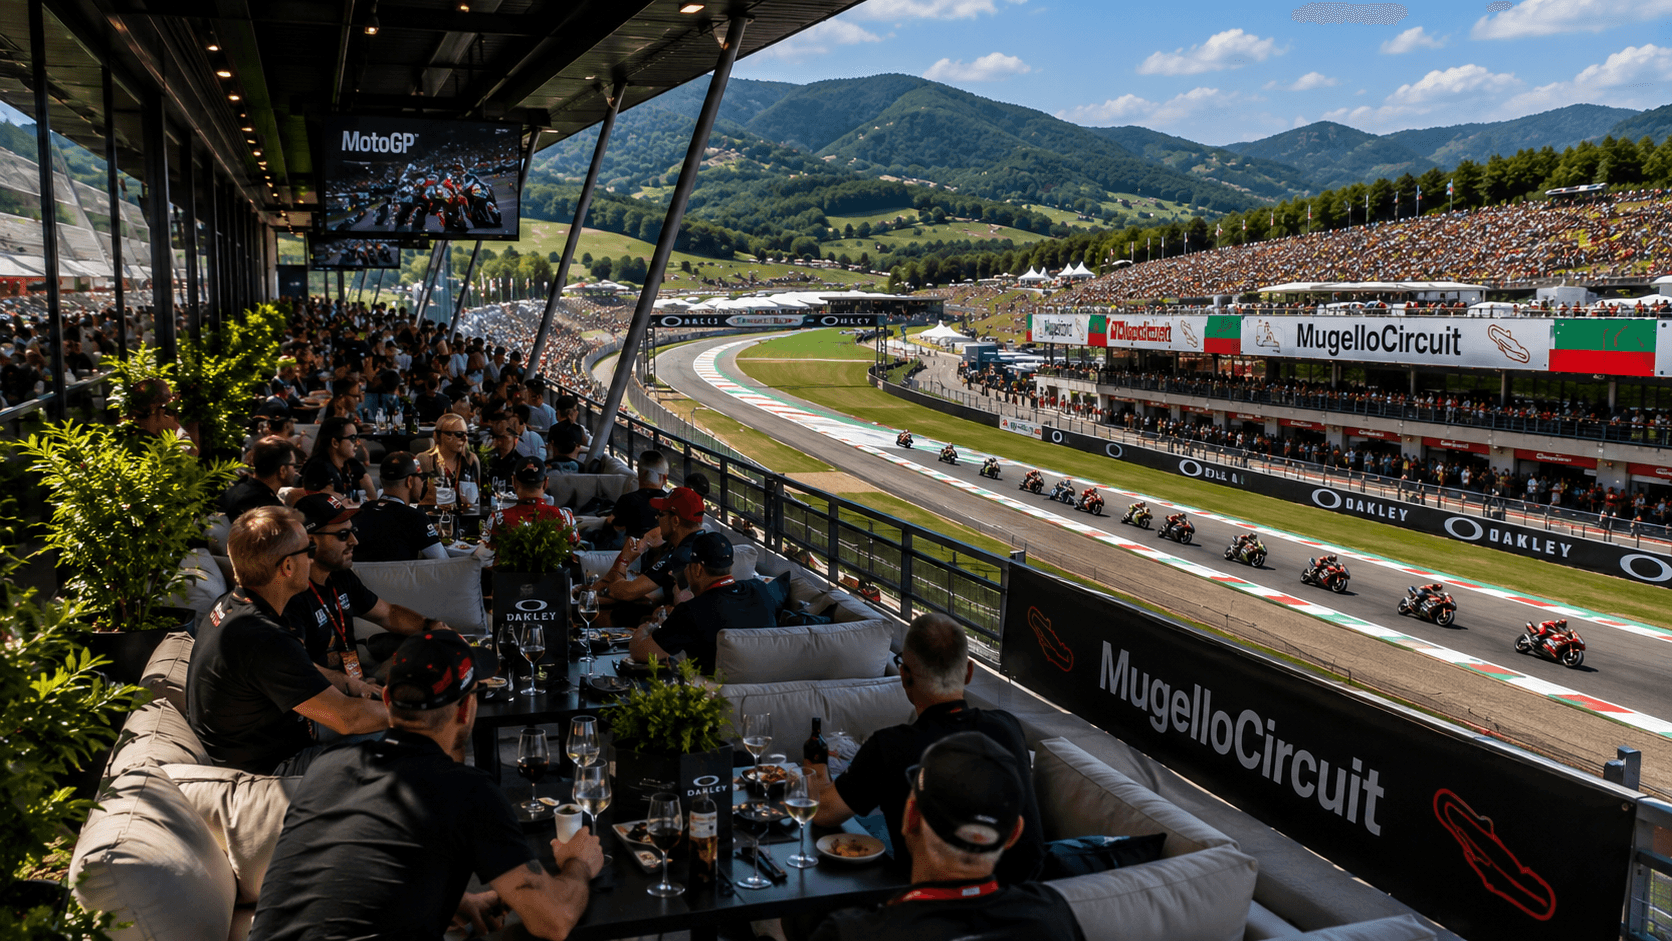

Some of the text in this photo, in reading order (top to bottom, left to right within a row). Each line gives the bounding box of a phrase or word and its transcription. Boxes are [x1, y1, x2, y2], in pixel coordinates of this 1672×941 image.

[1296, 323, 1462, 356] MugelloCircuit
[1345, 497, 1408, 522] OAKLEY
[1489, 528, 1573, 558] OAKLEY
[1100, 640, 1385, 836] MugelloCircuit
